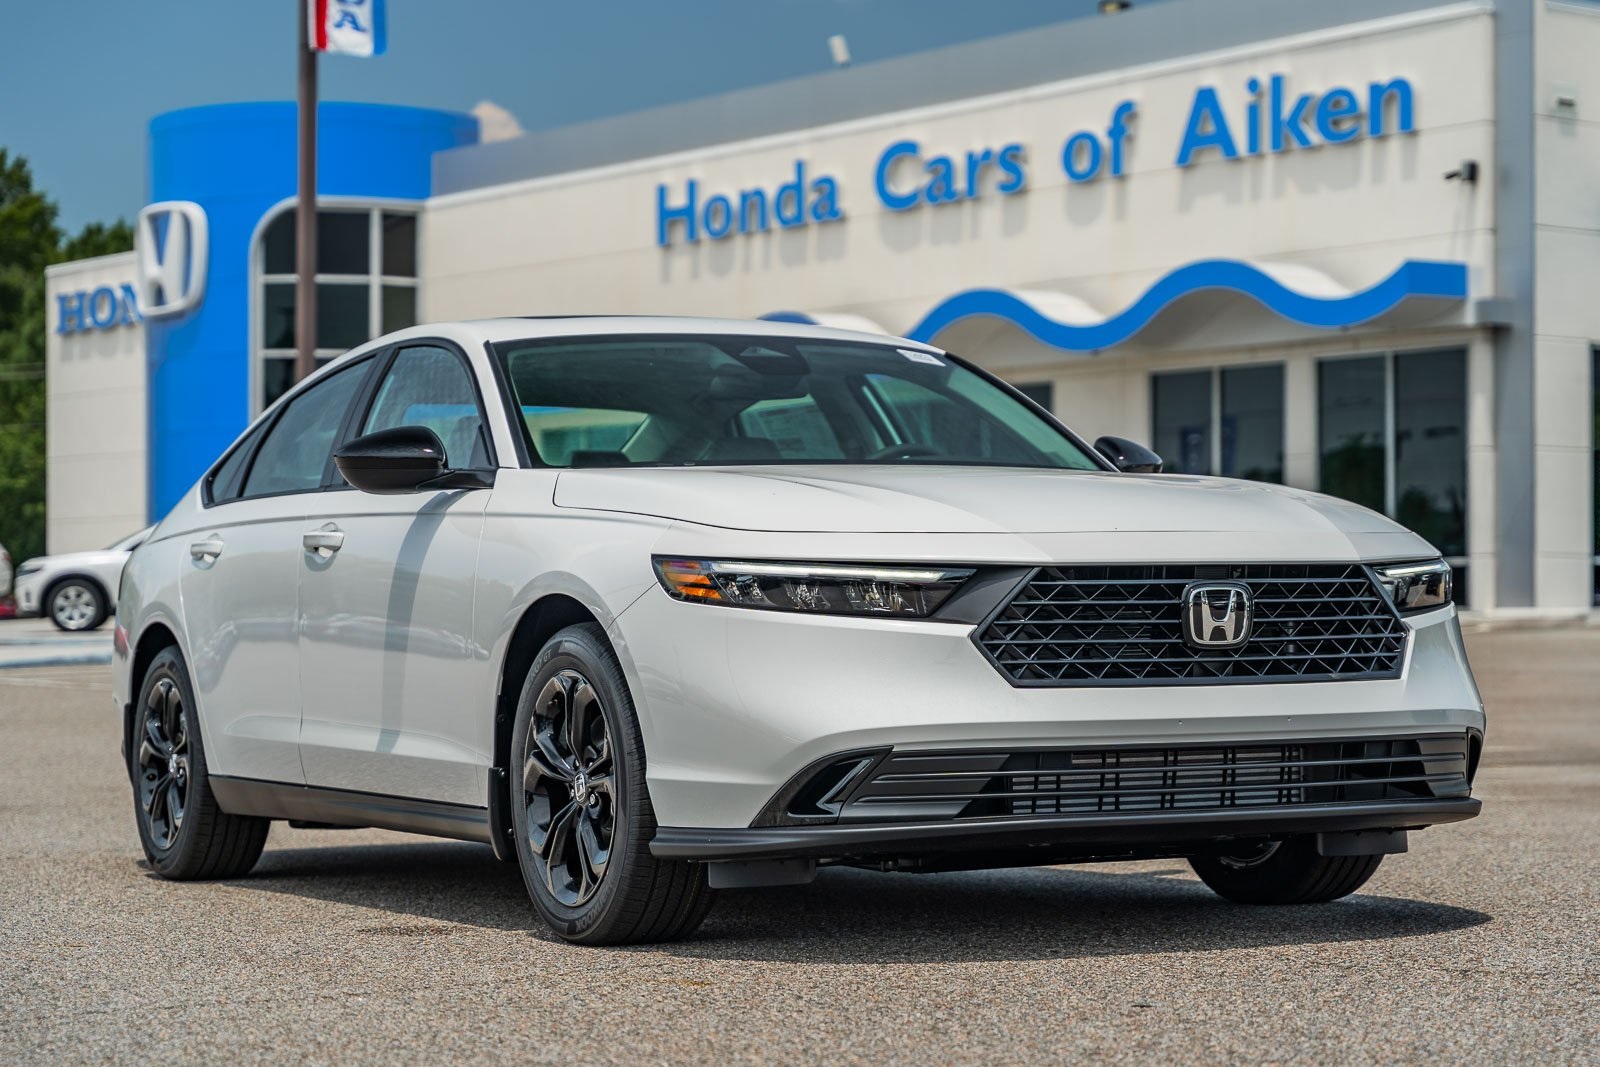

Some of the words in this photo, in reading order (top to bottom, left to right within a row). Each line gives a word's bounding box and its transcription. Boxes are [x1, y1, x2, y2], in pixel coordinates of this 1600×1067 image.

[656, 160, 843, 247] Honda
[874, 140, 1026, 210] Cars
[1062, 100, 1136, 182] of
[1175, 74, 1415, 167] Aiken
